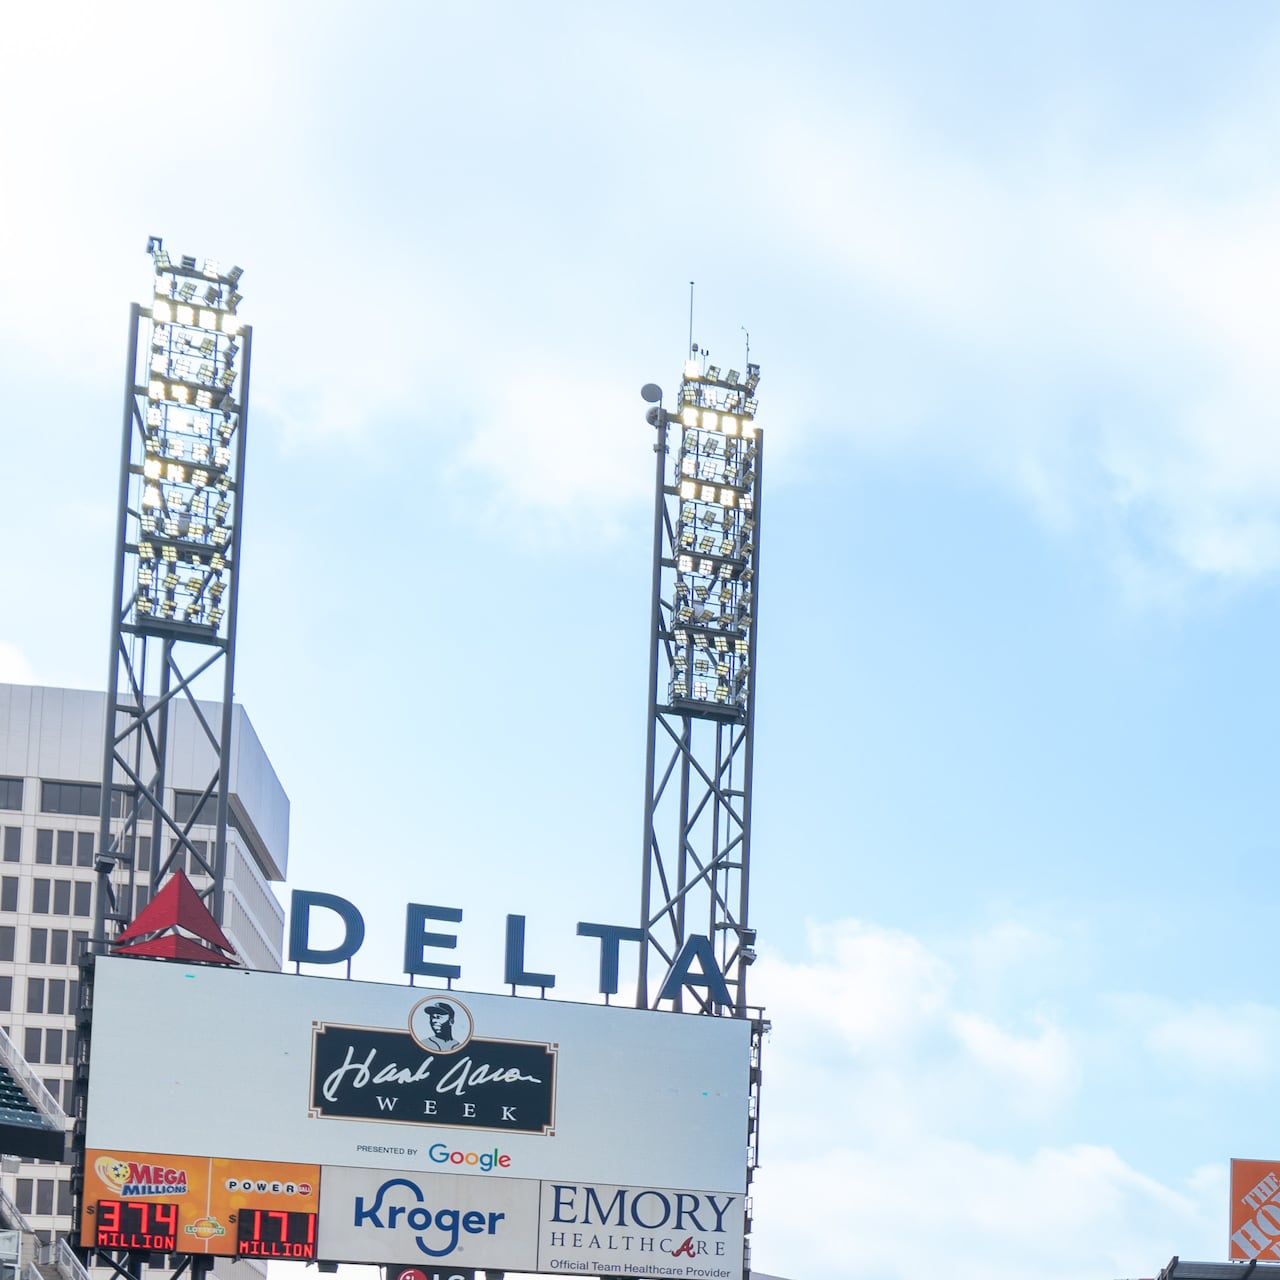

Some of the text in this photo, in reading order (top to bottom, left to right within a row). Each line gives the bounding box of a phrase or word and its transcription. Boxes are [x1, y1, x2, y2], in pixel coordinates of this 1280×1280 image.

[291, 889, 732, 1006] DELTA
[323, 1046, 434, 1102] Hank
[376, 1096, 517, 1121] WEEK
[356, 1145, 405, 1155] PRESENTED
[428, 1143, 511, 1172] Google
[128, 1163, 187, 1185] MEGA
[121, 1184, 187, 1196] MILLIONS
[99, 1202, 177, 1235] 374
[354, 1178, 505, 1257] Kroger
[549, 1184, 736, 1232] EMORY
[253, 1210, 315, 1243] 171
[98, 1233, 175, 1250] MILLION
[240, 1241, 313, 1258] MILLION
[551, 1232, 726, 1258] HEALTHCARE
[550, 1259, 731, 1278] Official Team Healthcare Provider
